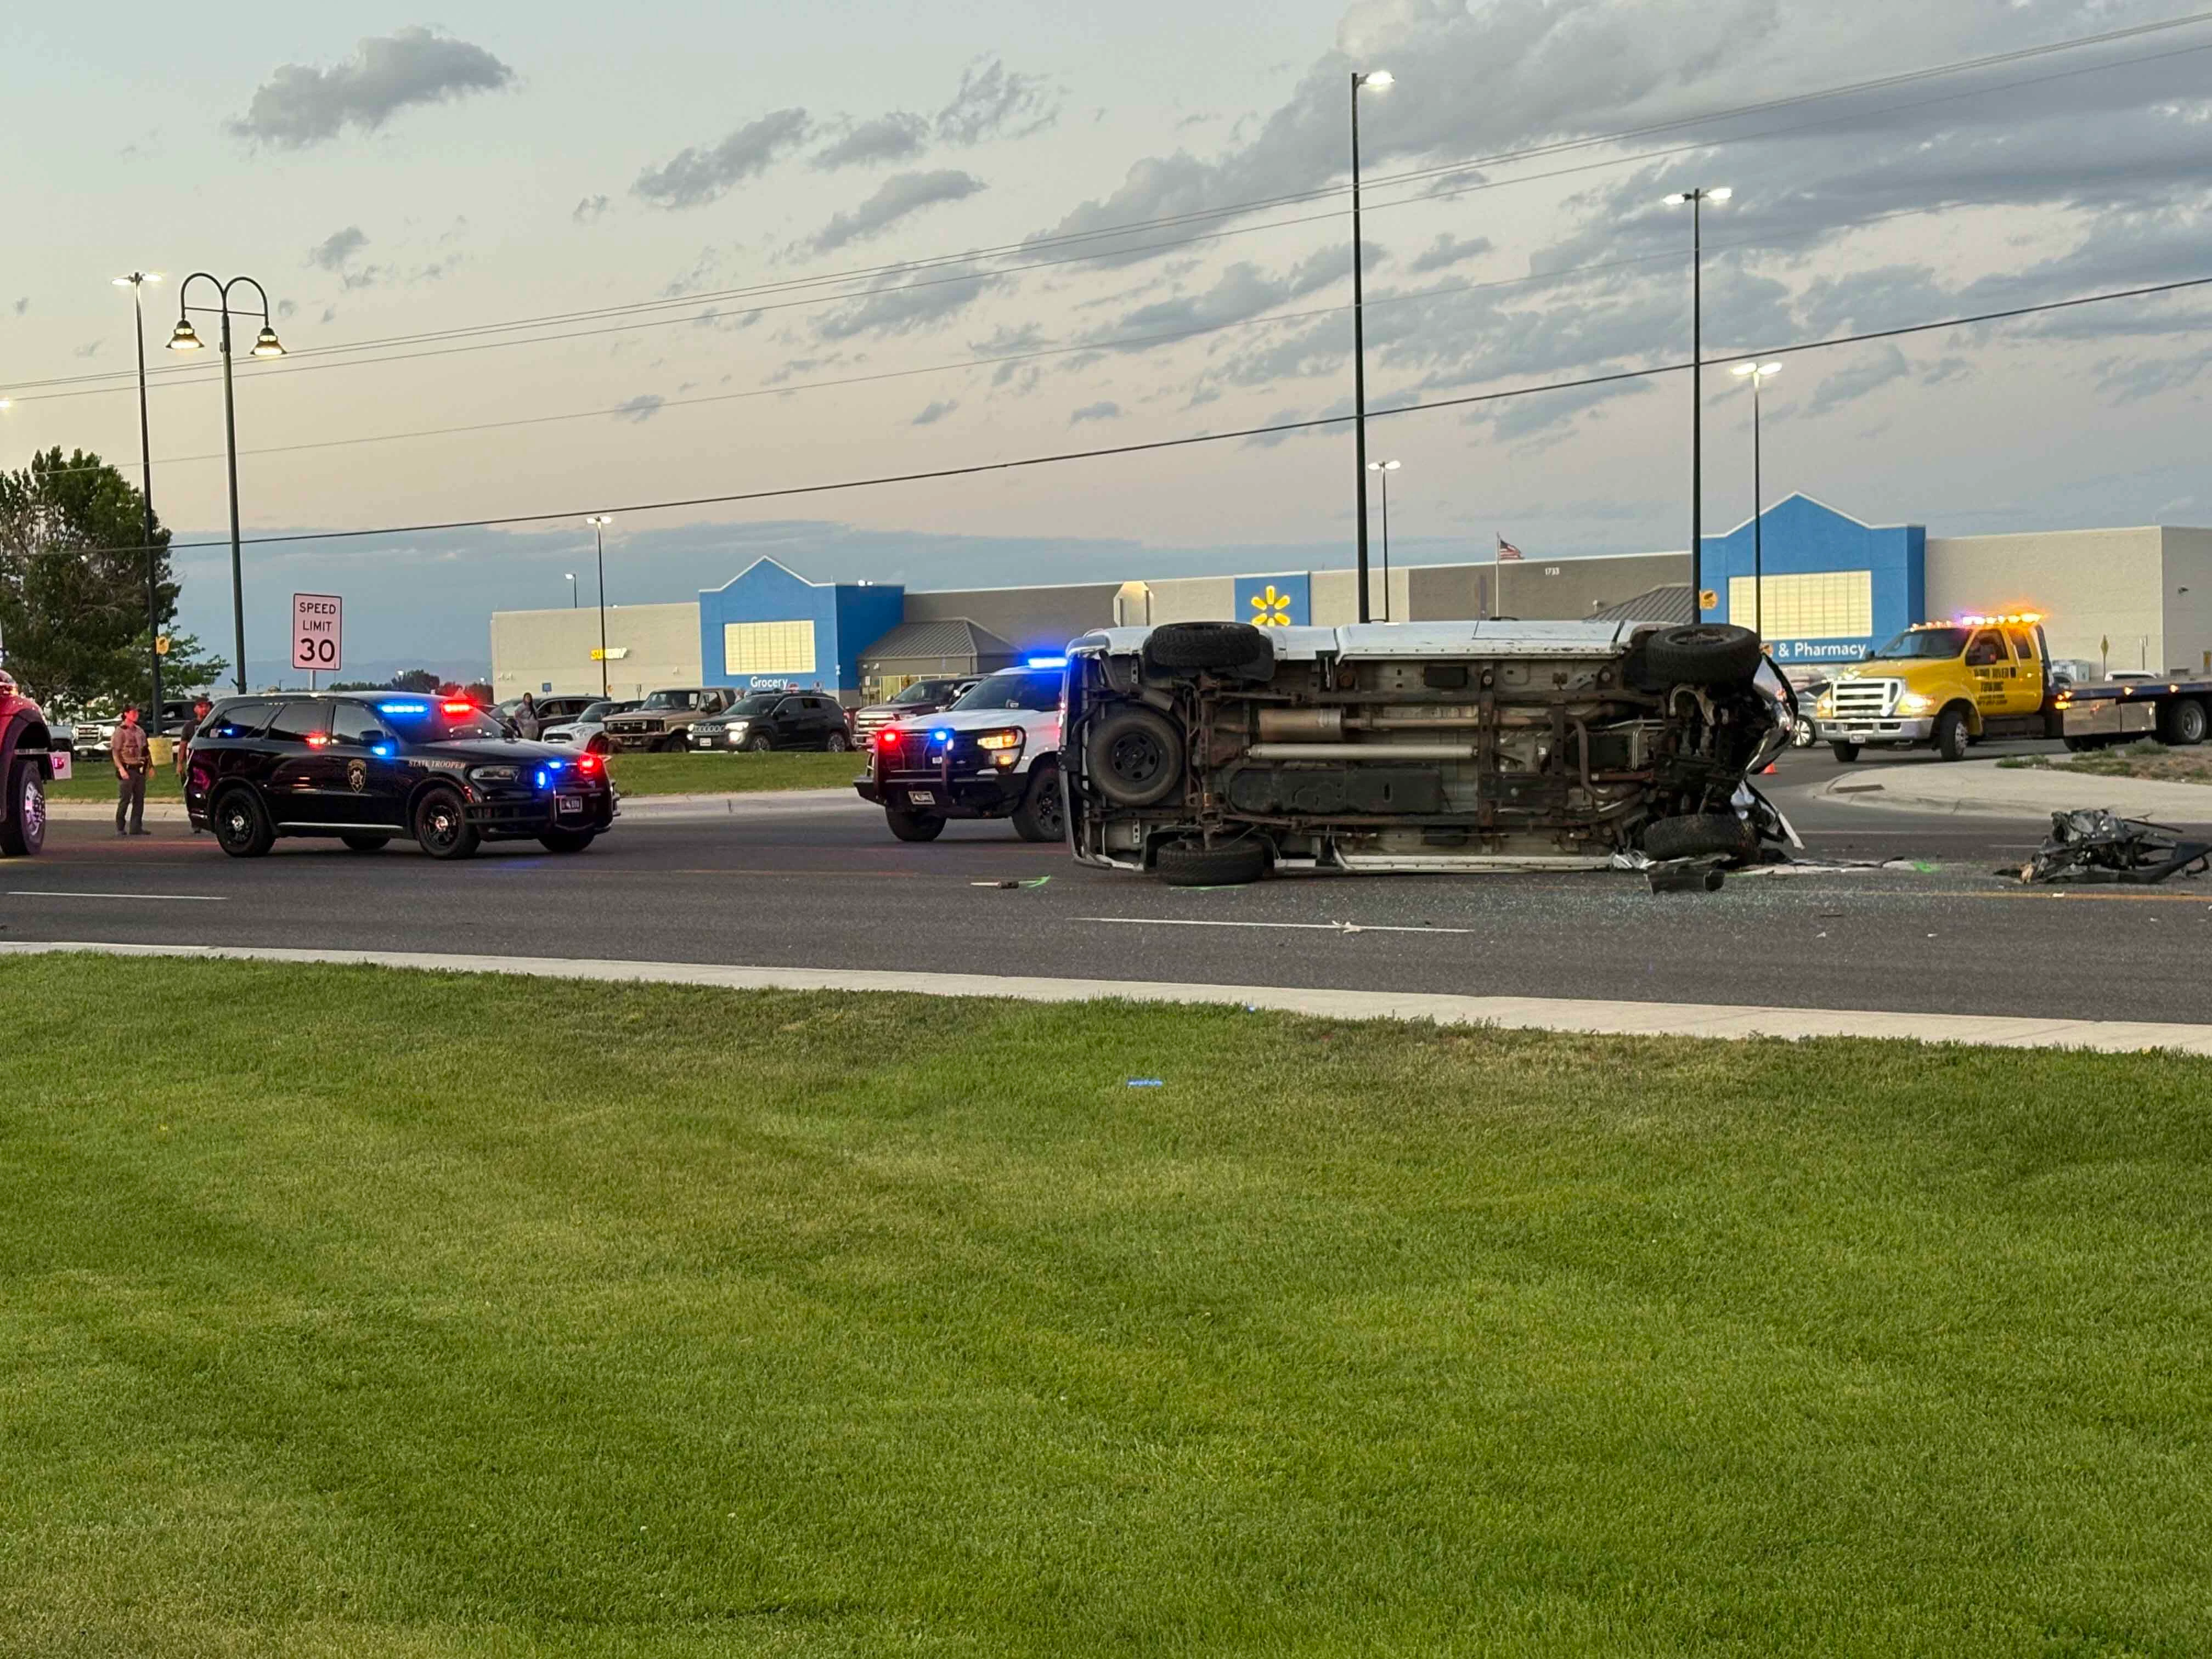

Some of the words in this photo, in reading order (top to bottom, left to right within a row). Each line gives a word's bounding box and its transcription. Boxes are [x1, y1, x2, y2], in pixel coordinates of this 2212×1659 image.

[300, 602, 336, 614] SPEED
[303, 620, 332, 632] LIMIT
[299, 637, 335, 662] 30
[1779, 642, 1790, 657] &
[1795, 642, 1866, 658] Pharmacy
[751, 676, 788, 690] Grocery
[408, 759, 430, 768] STATE
[431, 760, 466, 769] TROOPER
